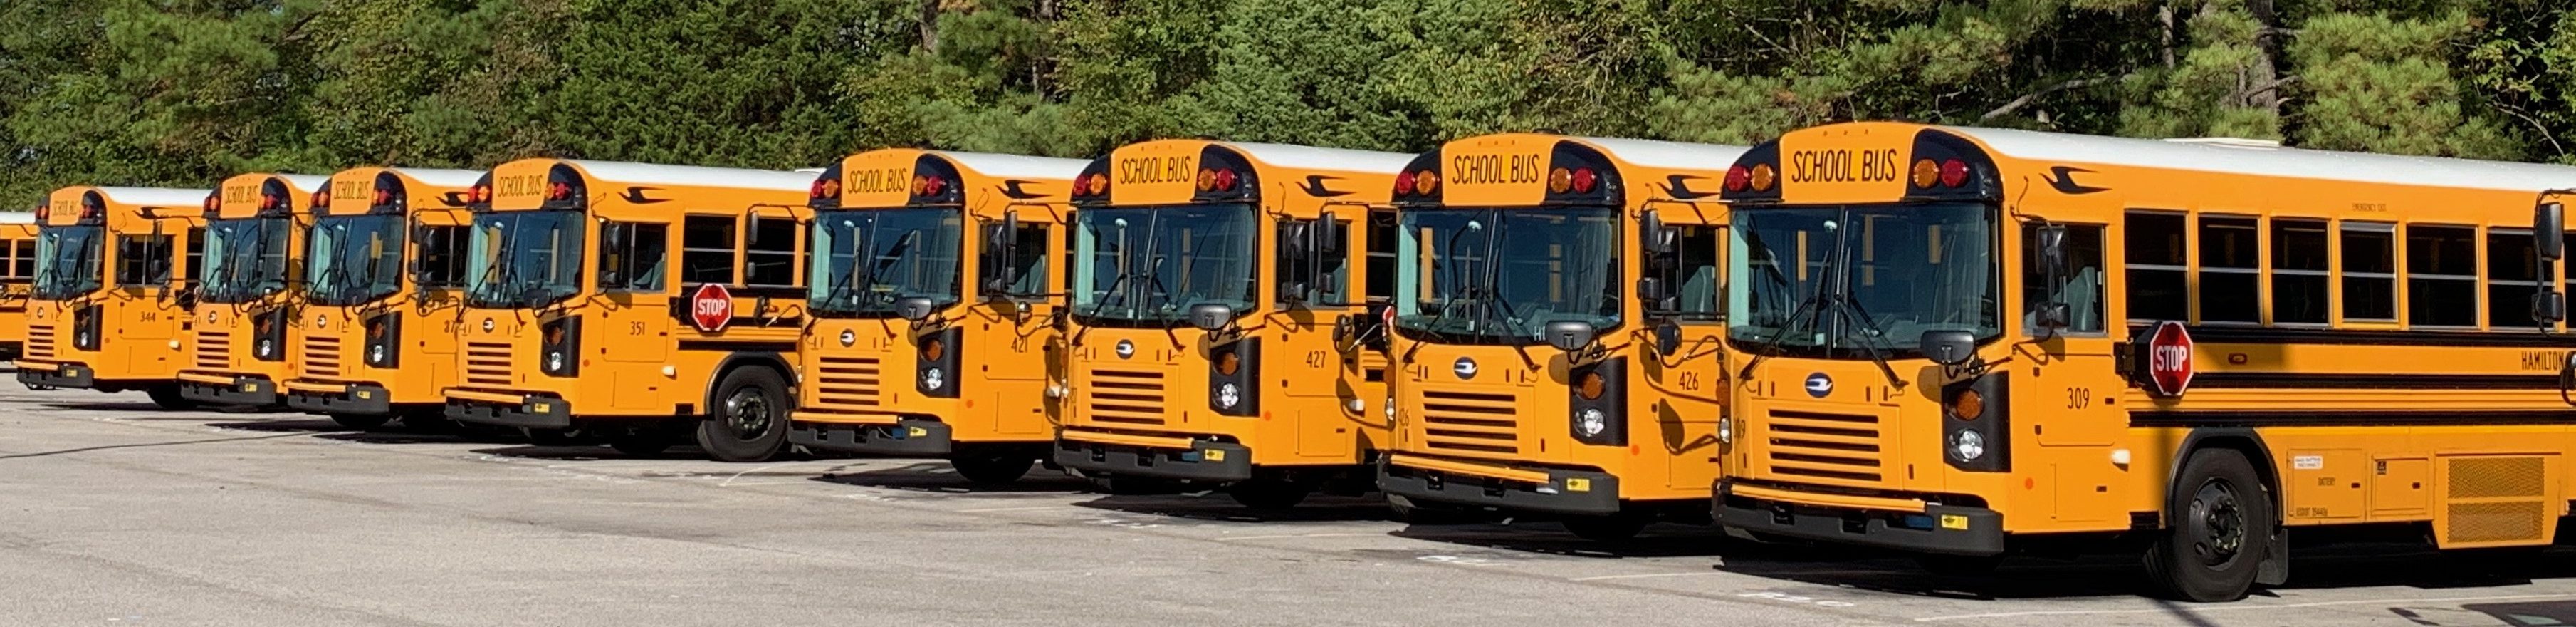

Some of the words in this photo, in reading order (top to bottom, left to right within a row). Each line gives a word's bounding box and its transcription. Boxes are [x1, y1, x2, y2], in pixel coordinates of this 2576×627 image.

[1120, 157, 1163, 184] SCHOOL
[1167, 155, 1191, 182] BUS
[1452, 154, 1506, 185] SCHOOL
[1510, 153, 1540, 184] BUS
[1791, 149, 1855, 182] SCHOOL
[1861, 148, 1897, 182] BUS
[334, 180, 355, 200] SCHOOL
[356, 180, 370, 200] BUS
[498, 175, 525, 197] SCHOOL
[526, 175, 543, 196] BUS
[847, 169, 883, 194] SCHOOL
[886, 167, 907, 192] BUS
[225, 185, 245, 204] SCHOOL
[140, 311, 156, 322] 344
[698, 298, 726, 316] STOP
[630, 321, 646, 336] 351
[1011, 336, 1028, 353] 421
[1306, 350, 1326, 368] 427
[2156, 345, 2187, 371] STOP
[2521, 351, 2565, 370] HAMILTON
[1679, 370, 1699, 390] 426
[2067, 387, 2090, 409] 309
